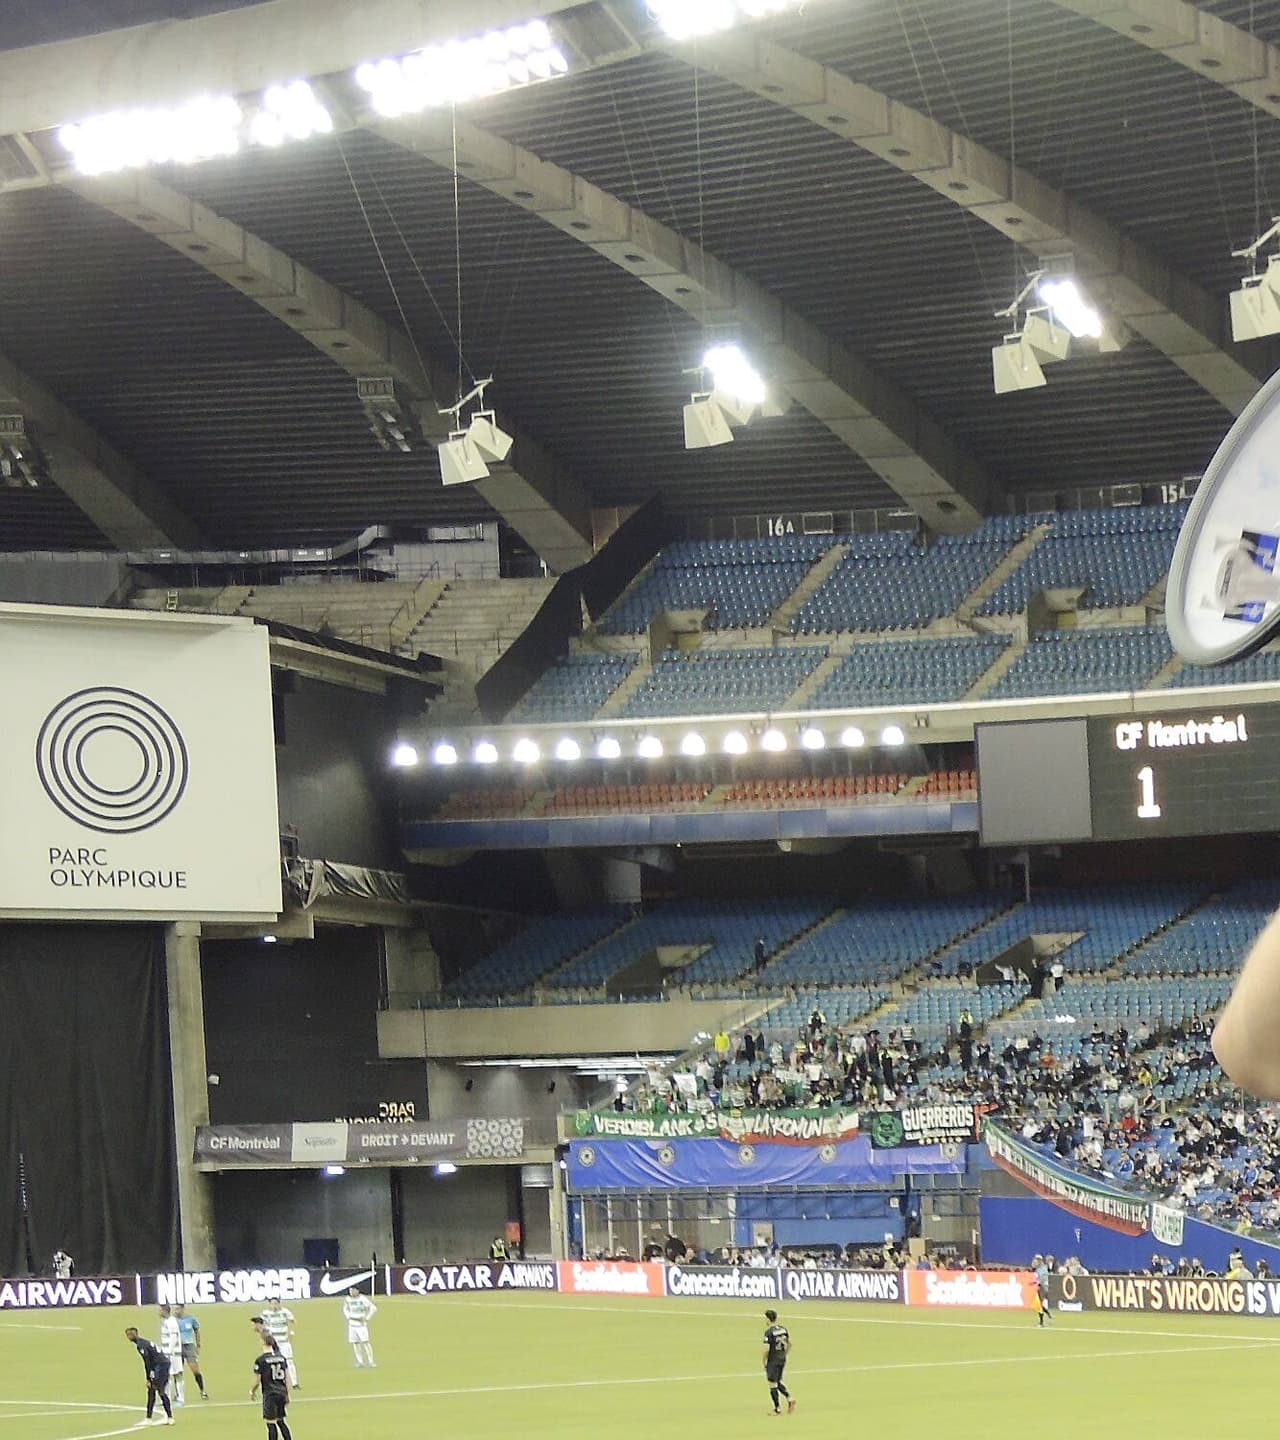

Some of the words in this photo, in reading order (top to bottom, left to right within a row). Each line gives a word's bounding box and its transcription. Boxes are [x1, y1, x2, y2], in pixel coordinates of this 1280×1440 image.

[767, 514, 794, 536] 16A
[1116, 721, 1143, 749] CF
[1138, 766, 1161, 818] 1
[49, 848, 108, 866] PARC
[50, 869, 188, 889] OLYMPIQUE
[902, 1105, 974, 1131] GUERREROS
[361, 1134, 399, 1148] DROIT
[411, 1133, 455, 1146] DEVANT
[157, 1272, 216, 1305] NIKE
[220, 1268, 312, 1303] SOCCER
[403, 1265, 493, 1295] QATAR
[498, 1261, 554, 1289] AIRWAYS
[669, 1266, 776, 1298] Concacaf.com
[786, 1270, 836, 1301] QATAR
[837, 1272, 899, 1300] AIRWAYS
[0, 1280, 122, 1307] AIRWAYS
[1092, 1279, 1162, 1310] WHAT'S
[1164, 1280, 1245, 1313] WRONG
[1247, 1282, 1267, 1314] IS
[271, 1364, 285, 1381] 16
